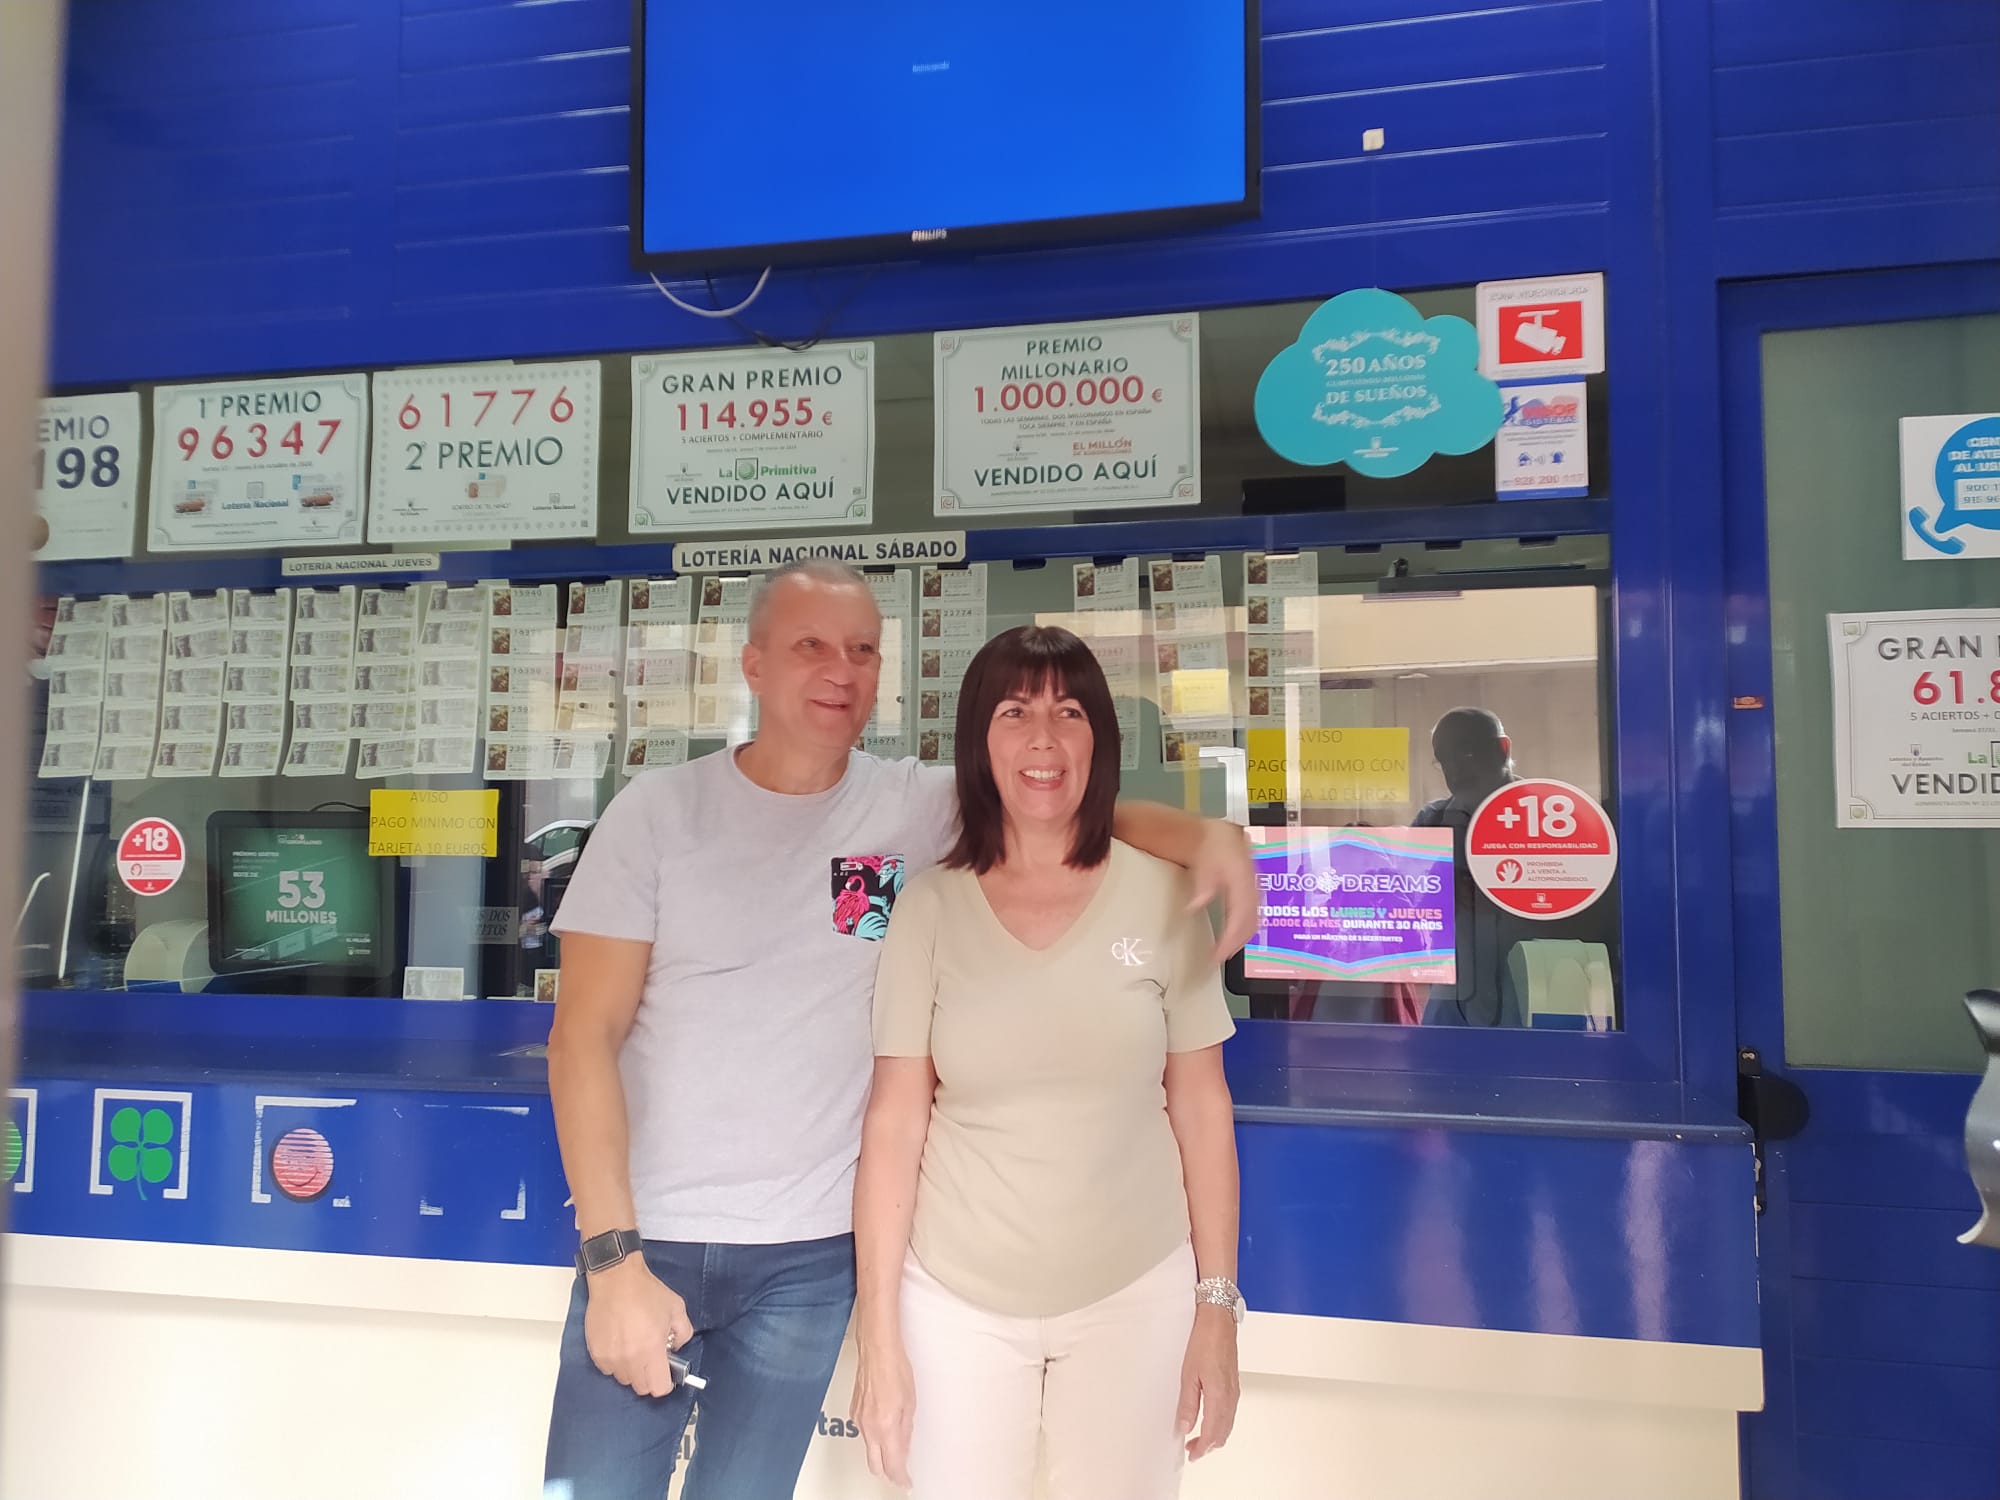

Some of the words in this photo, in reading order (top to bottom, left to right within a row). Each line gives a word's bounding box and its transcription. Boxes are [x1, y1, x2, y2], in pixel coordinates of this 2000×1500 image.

[911, 229, 947, 242] PHILIPS
[1026, 336, 1103, 356] PREMIO
[1000, 357, 1128, 381] MILLONARIO
[1326, 357, 1365, 376] 250
[1367, 353, 1426, 372] AÑOS
[662, 371, 735, 394] GRAN
[746, 365, 842, 390] PREMIO
[220, 390, 321, 418] PREMIO
[974, 375, 1144, 413] 1.000.000
[1151, 388, 1163, 403] €
[1326, 391, 1350, 404] DE
[1354, 384, 1427, 402] SUEÑOS
[398, 385, 574, 430] 61776
[677, 397, 813, 431] 114.955
[822, 411, 833, 426] €
[36, 414, 110, 443] EMIO
[688, 434, 729, 444] ACIERTOS
[739, 430, 823, 441] COMPLEMENTARIO
[177, 419, 342, 461] 96347
[1072, 441, 1086, 450] EL
[1088, 437, 1132, 449] MILLÓN
[438, 436, 563, 469] PREMIO
[718, 467, 733, 478] La
[760, 464, 817, 477] Primitiva
[974, 464, 1082, 487] VENDIDO
[1093, 455, 1157, 481] AQUÍ
[666, 483, 766, 505] VENDIDO
[775, 476, 834, 501] AQUÍ
[681, 544, 762, 568] LOTERÍA
[875, 538, 963, 559] SÁBADO
[289, 562, 333, 572] LOTERÍA
[335, 560, 388, 570] NACIONAL
[391, 557, 433, 567] JUEVES
[1878, 634, 1983, 661] GRAN
[1910, 711, 1917, 721] 5
[1921, 710, 1980, 721] ACIERTOS
[1297, 730, 1343, 744] AVISO
[1369, 759, 1406, 772] CON
[1967, 751, 1988, 764] La
[409, 791, 449, 804] AVISO
[1248, 788, 1314, 801] TARJA
[370, 816, 407, 829] PAGO
[410, 817, 465, 829] MINIMO
[468, 817, 496, 829] CON
[1496, 794, 1577, 838] +18
[131, 827, 169, 852] +18
[369, 842, 423, 855] TARJETA
[427, 843, 442, 855] 10
[446, 843, 488, 856] EUROS
[277, 870, 326, 909] 53
[1341, 873, 1442, 894] DREAMS
[265, 910, 338, 924] MILLONES
[1301, 905, 1329, 918] LOS
[1330, 906, 1374, 919] LUNES
[1377, 907, 1387, 919] Y
[1388, 907, 1443, 920] JUEVES
[1257, 917, 1302, 928] 0.000€
[1342, 919, 1395, 931] DURANTE
[1412, 918, 1444, 931] AÑOS
